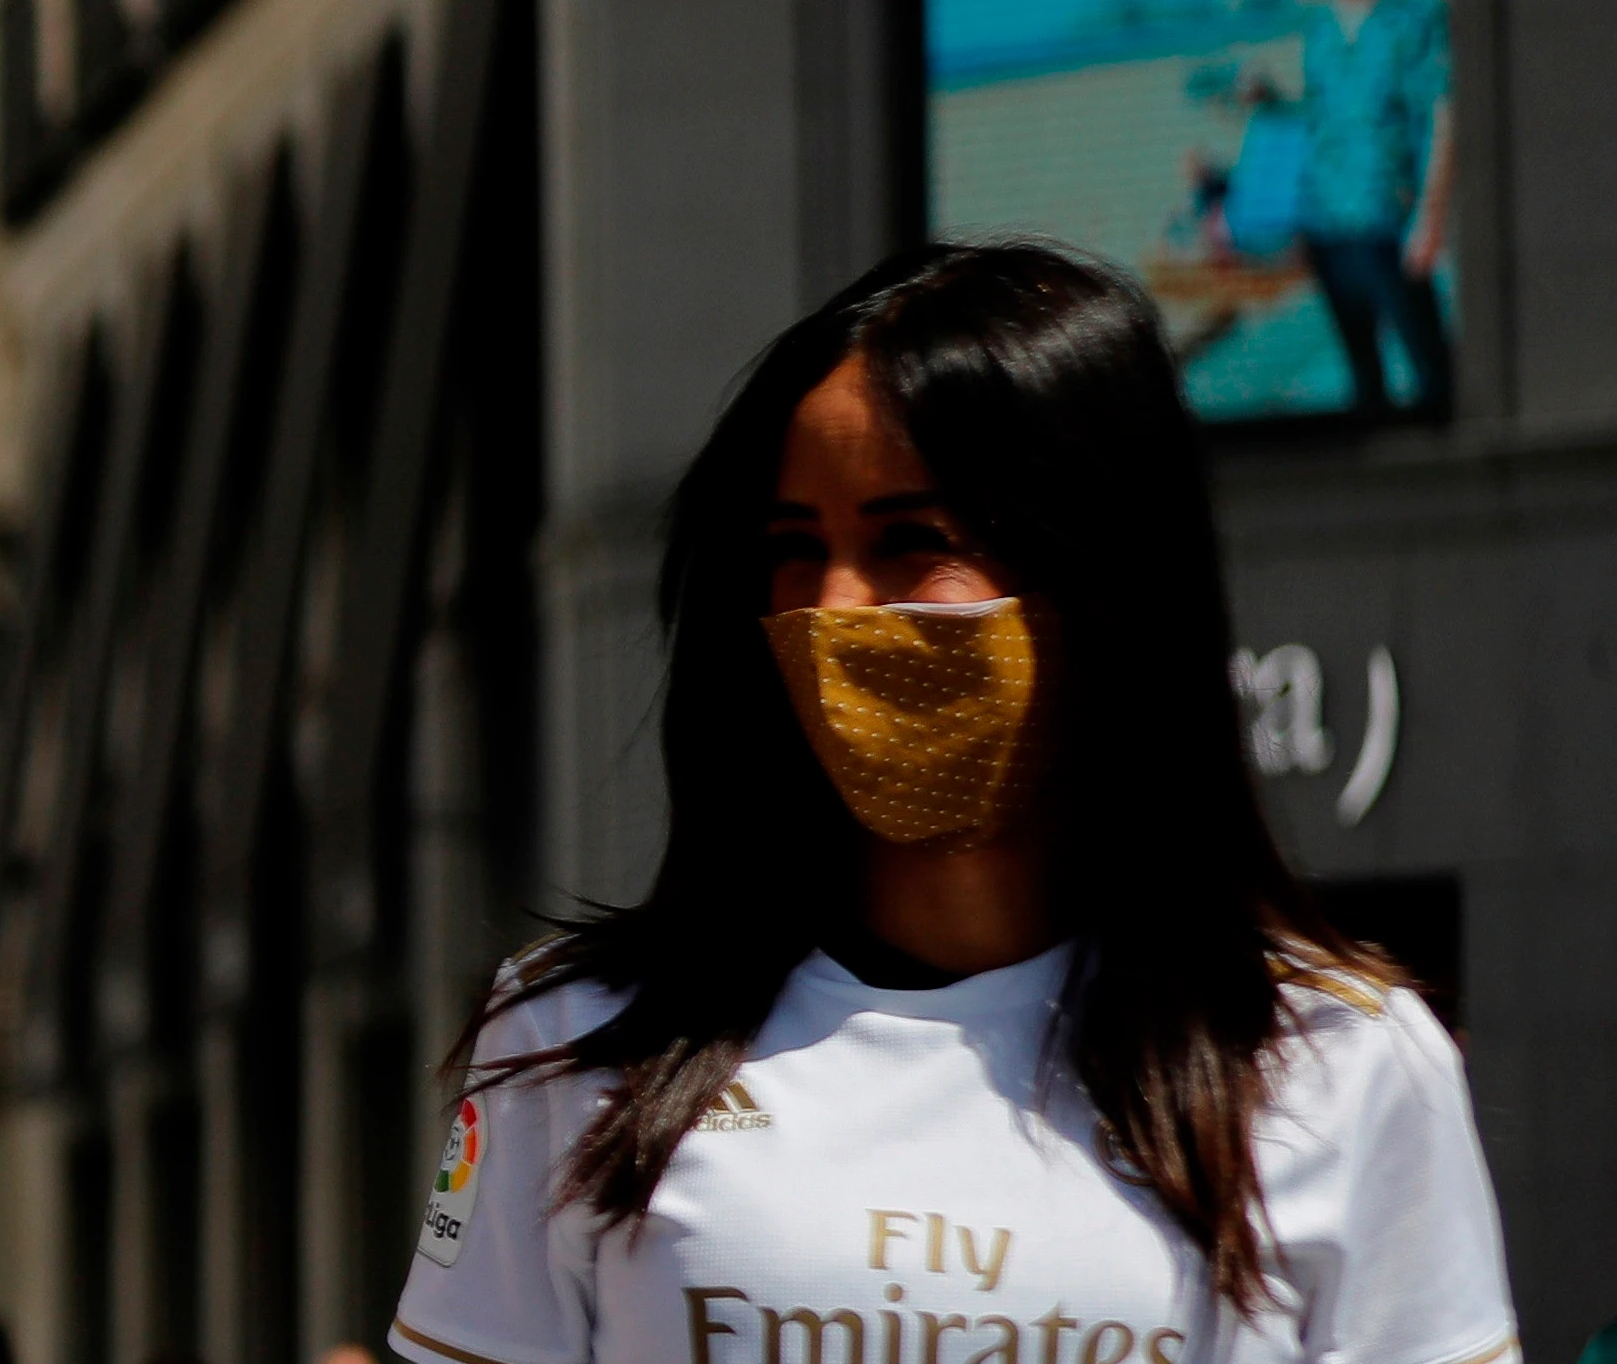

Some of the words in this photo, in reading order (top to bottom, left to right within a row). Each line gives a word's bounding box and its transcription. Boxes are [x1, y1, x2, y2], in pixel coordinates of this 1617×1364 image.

[695, 1108, 773, 1132] didas
[425, 1201, 461, 1240] Liga
[866, 1208, 1012, 1291] Fly
